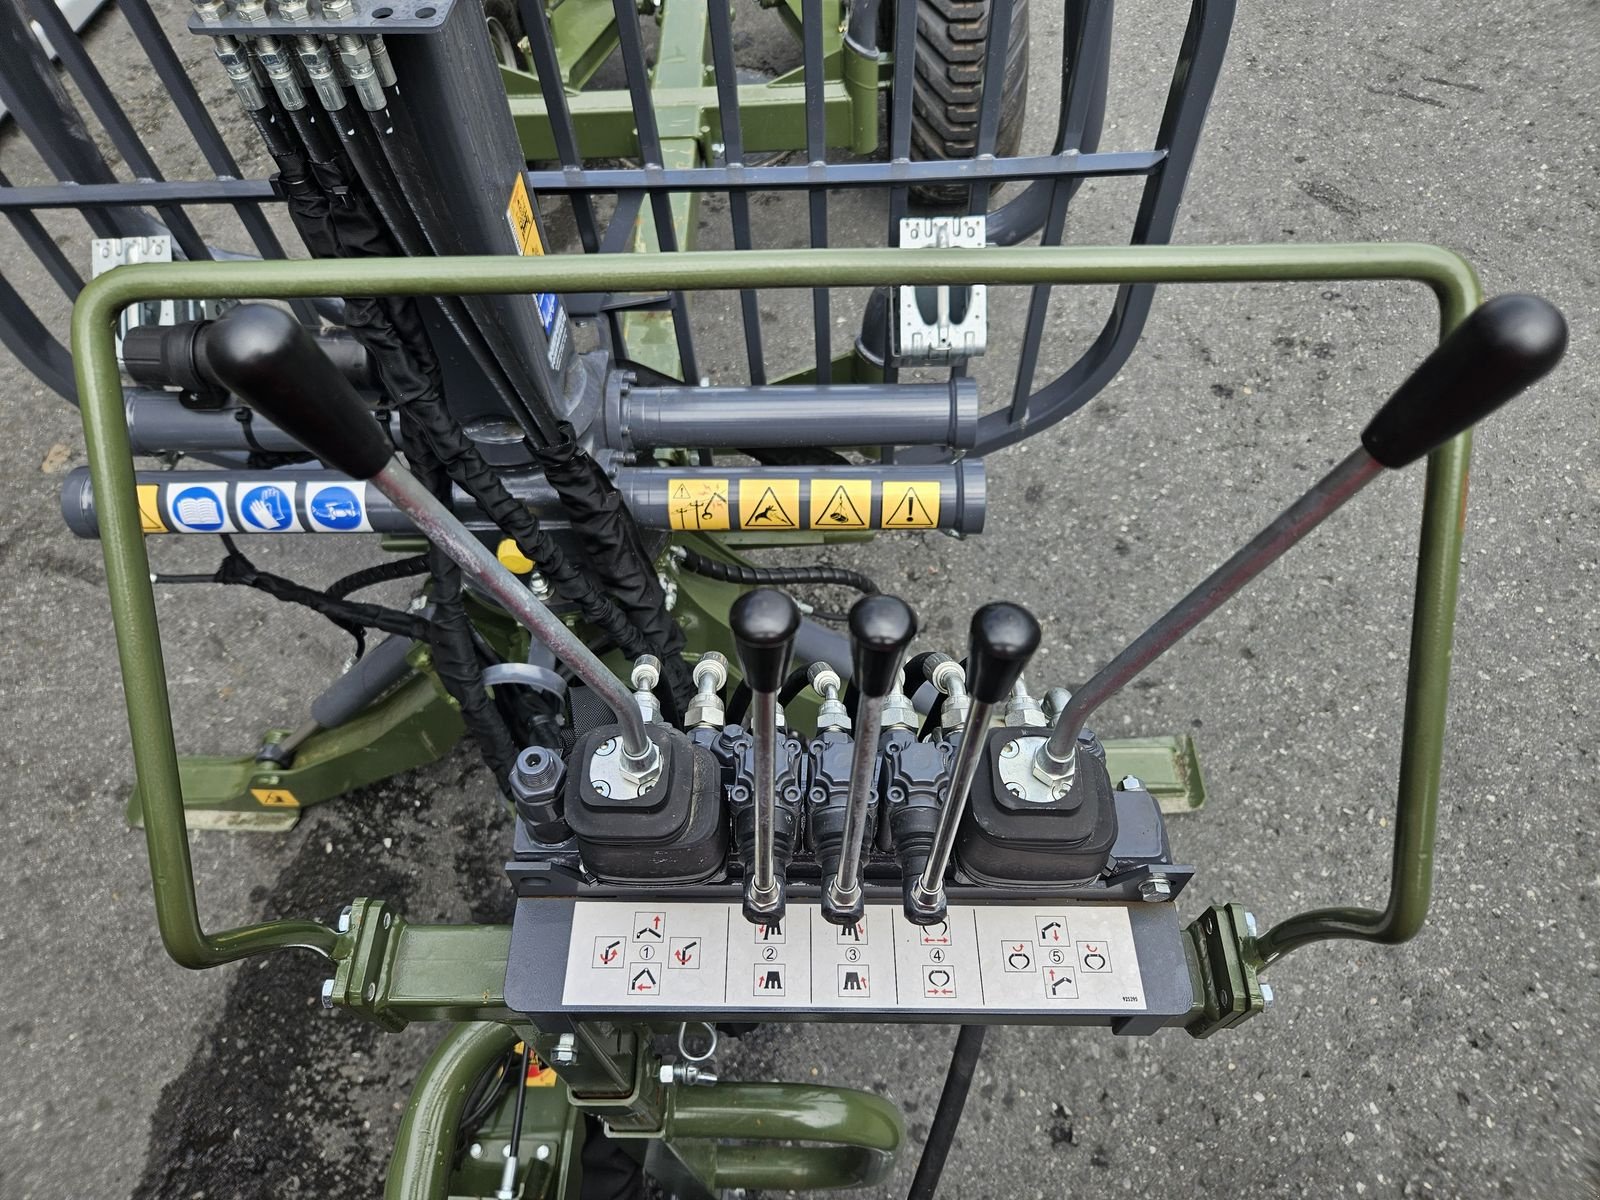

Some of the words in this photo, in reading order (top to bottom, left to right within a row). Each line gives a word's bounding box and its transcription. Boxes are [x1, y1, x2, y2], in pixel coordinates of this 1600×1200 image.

[642, 946, 650, 959] 1
[766, 947, 775, 960] 2
[849, 948, 857, 961] 3
[933, 949, 942, 962] 4
[1052, 950, 1061, 963] 5
